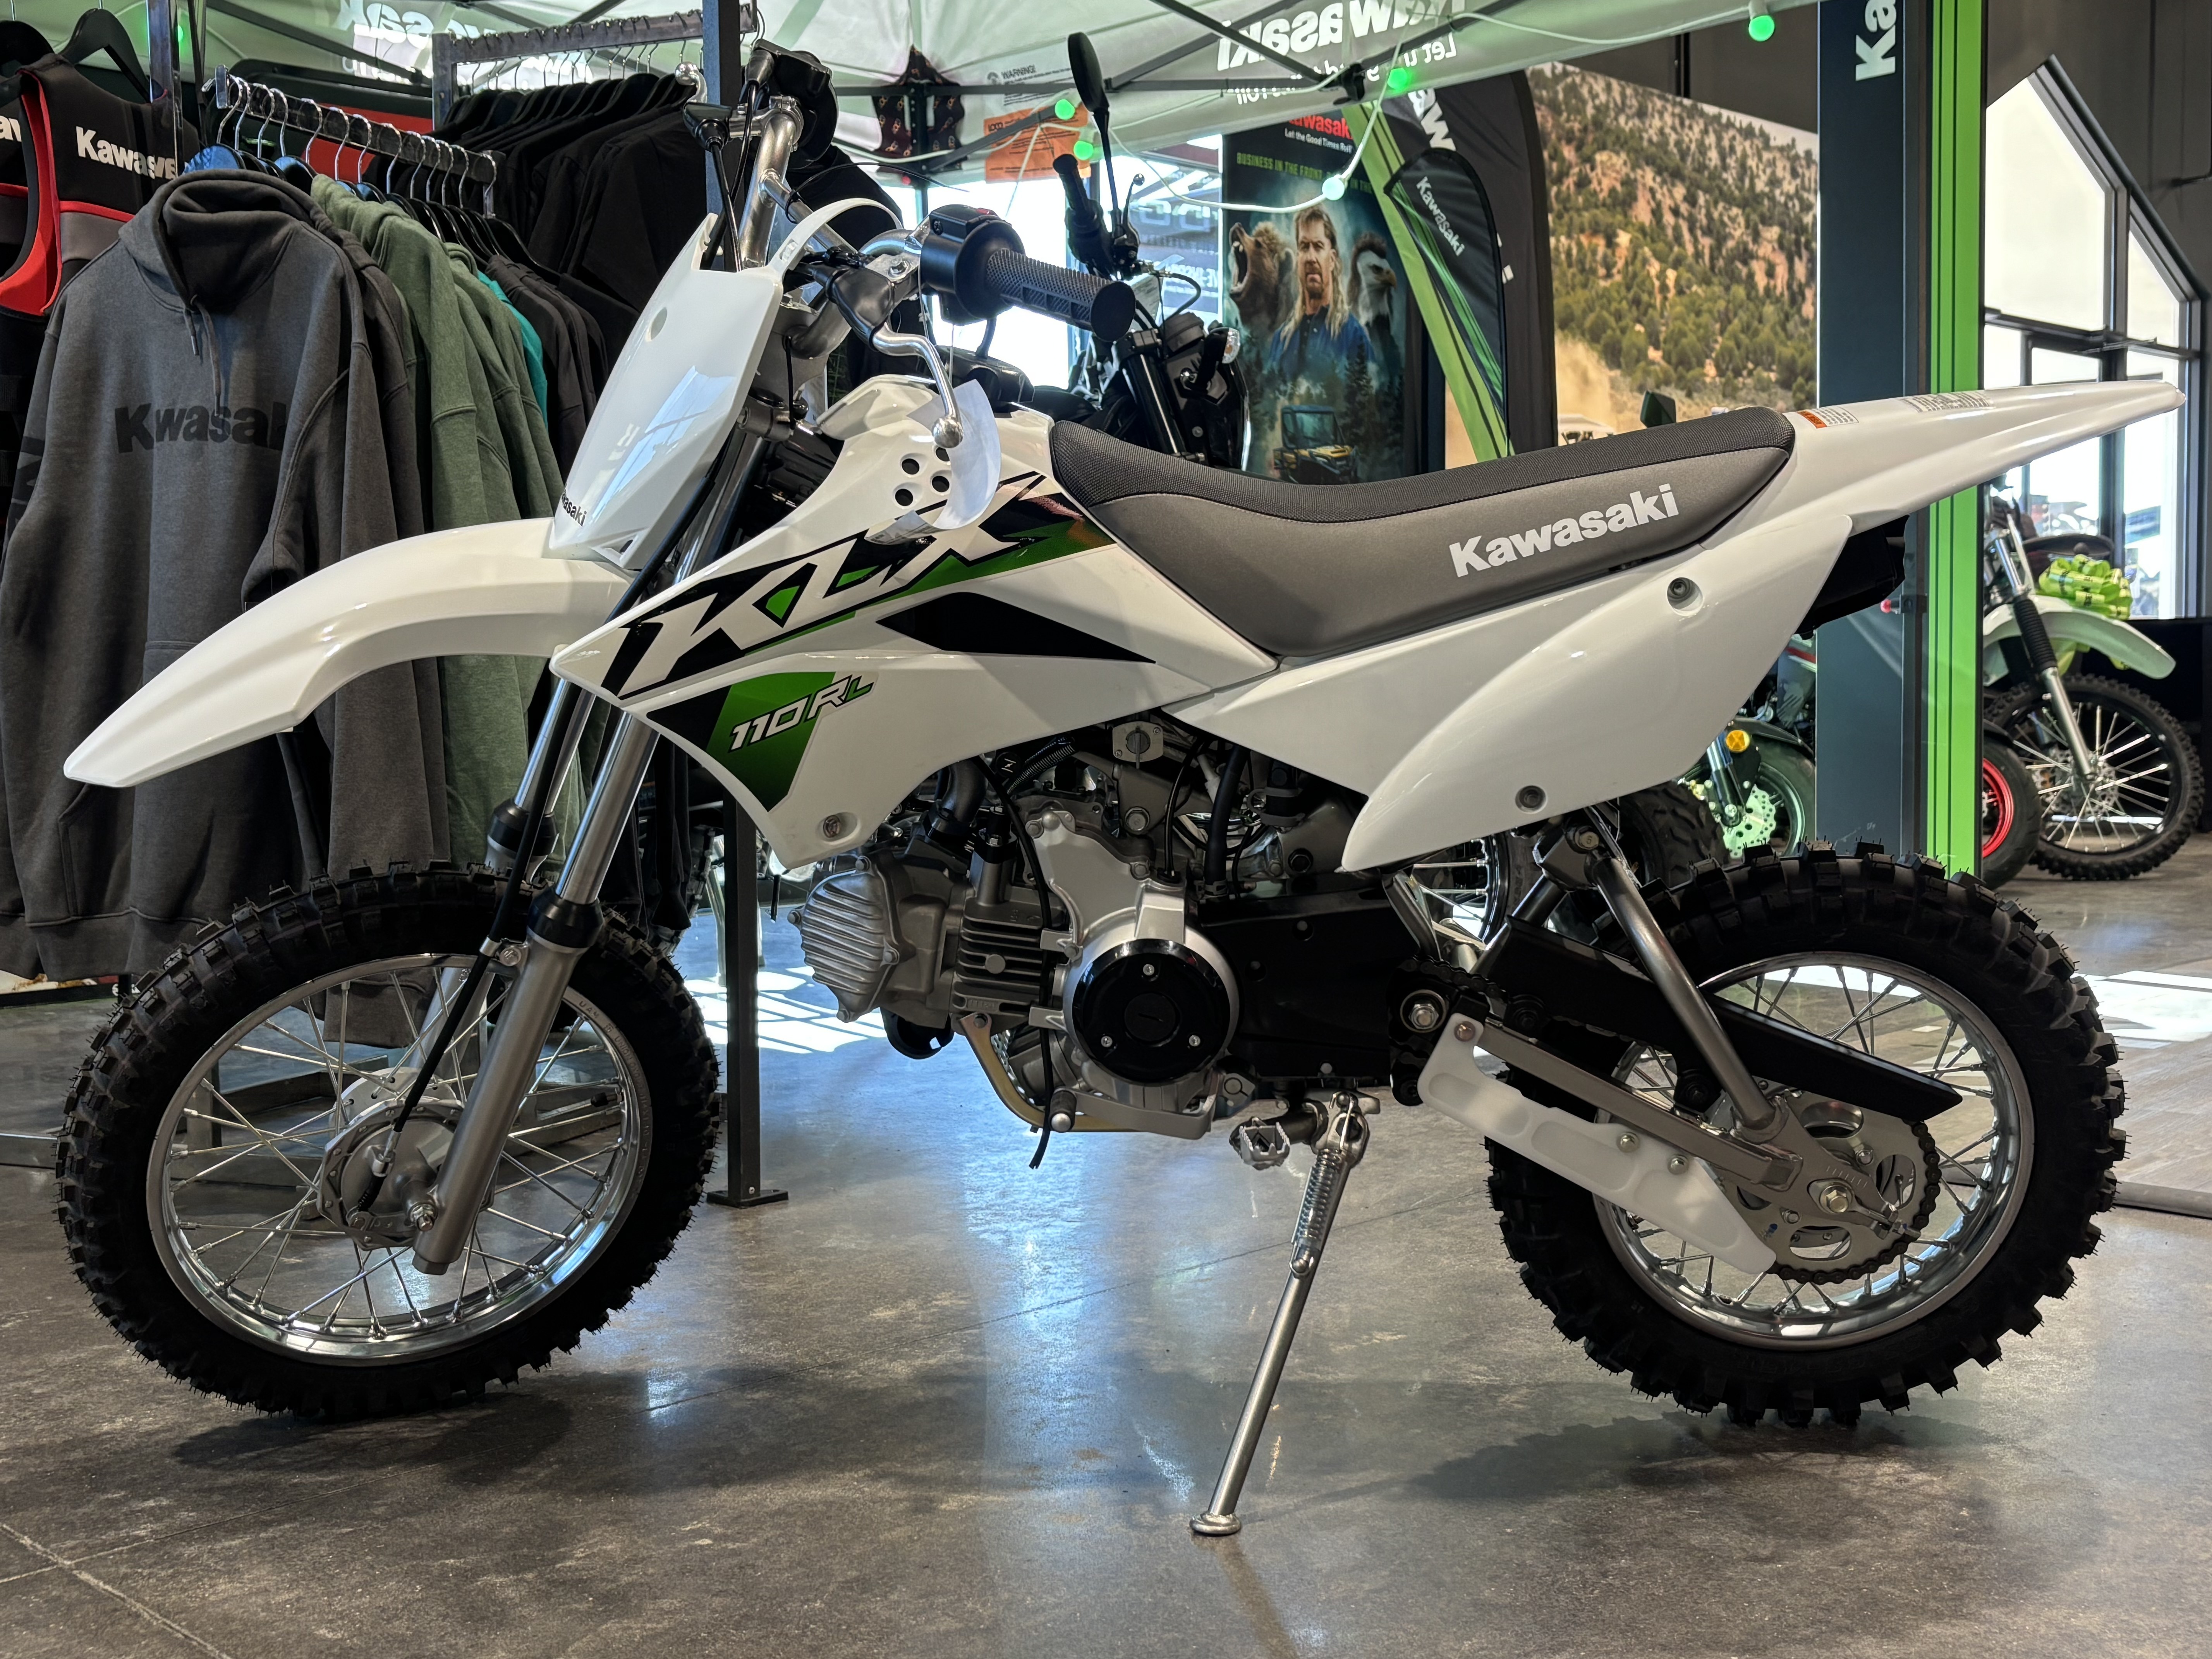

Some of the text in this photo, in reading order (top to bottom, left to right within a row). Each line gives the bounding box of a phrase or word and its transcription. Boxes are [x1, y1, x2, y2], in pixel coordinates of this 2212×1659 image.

[1237, 152, 1273, 170] BUSINESS
[1417, 176, 1465, 256] Kawasaki
[1449, 483, 1679, 577] Kawasaki
